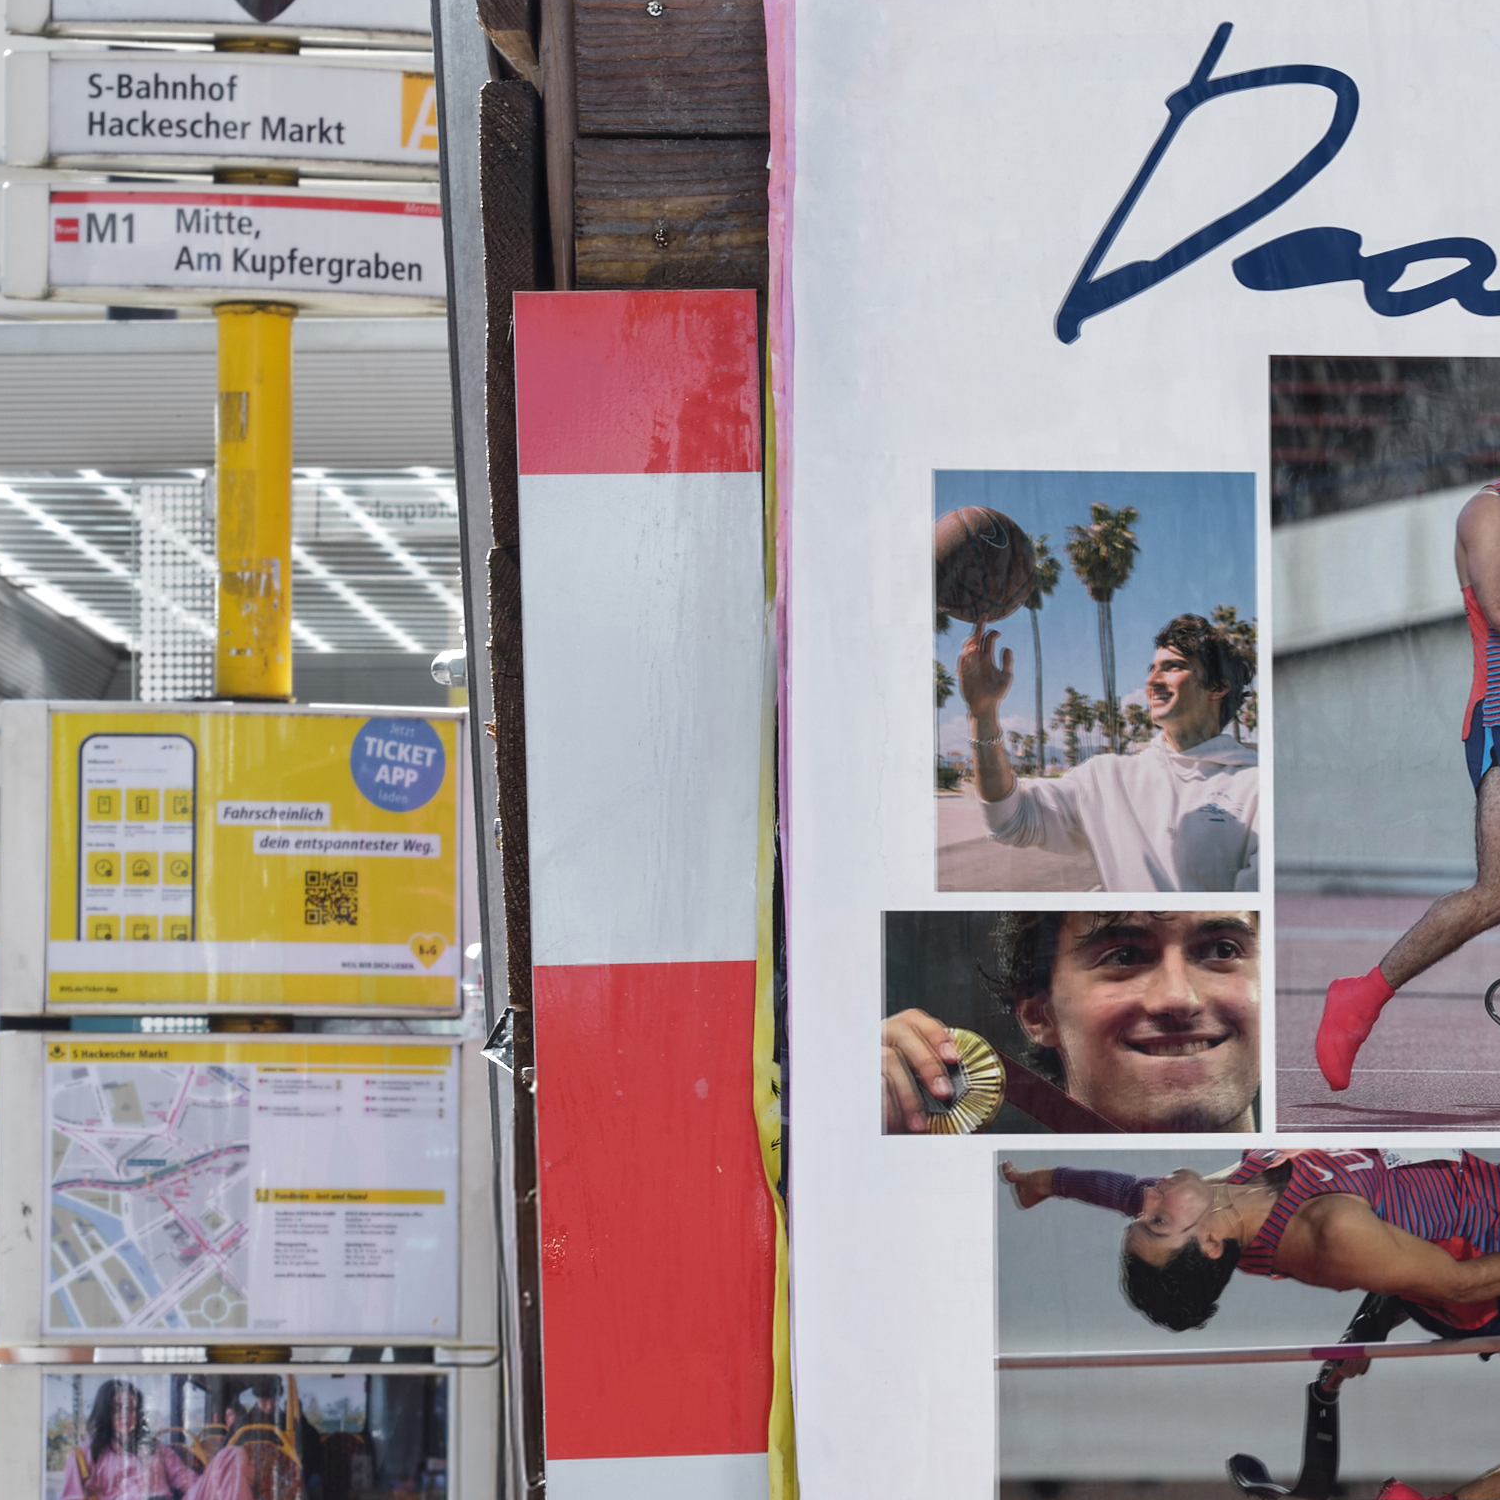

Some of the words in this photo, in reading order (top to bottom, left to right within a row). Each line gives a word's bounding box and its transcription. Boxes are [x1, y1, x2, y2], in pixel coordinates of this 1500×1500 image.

[88, 73, 239, 102] S-Bahnhof
[88, 111, 250, 140] Hackescher
[262, 116, 345, 145] Markt
[87, 212, 134, 243] M1
[175, 208, 262, 239] Mitte,
[174, 246, 221, 272] Am
[233, 247, 423, 284] Kupfergraben
[364, 736, 437, 768] TICKET
[375, 764, 419, 788] APP
[223, 806, 324, 821] Fahrscheinlich
[260, 835, 290, 849] dein
[295, 837, 399, 853] entspanntester
[403, 839, 434, 856] Weg.
[81, 1049, 136, 1058] Hackescher
[139, 1049, 168, 1058] Markt
